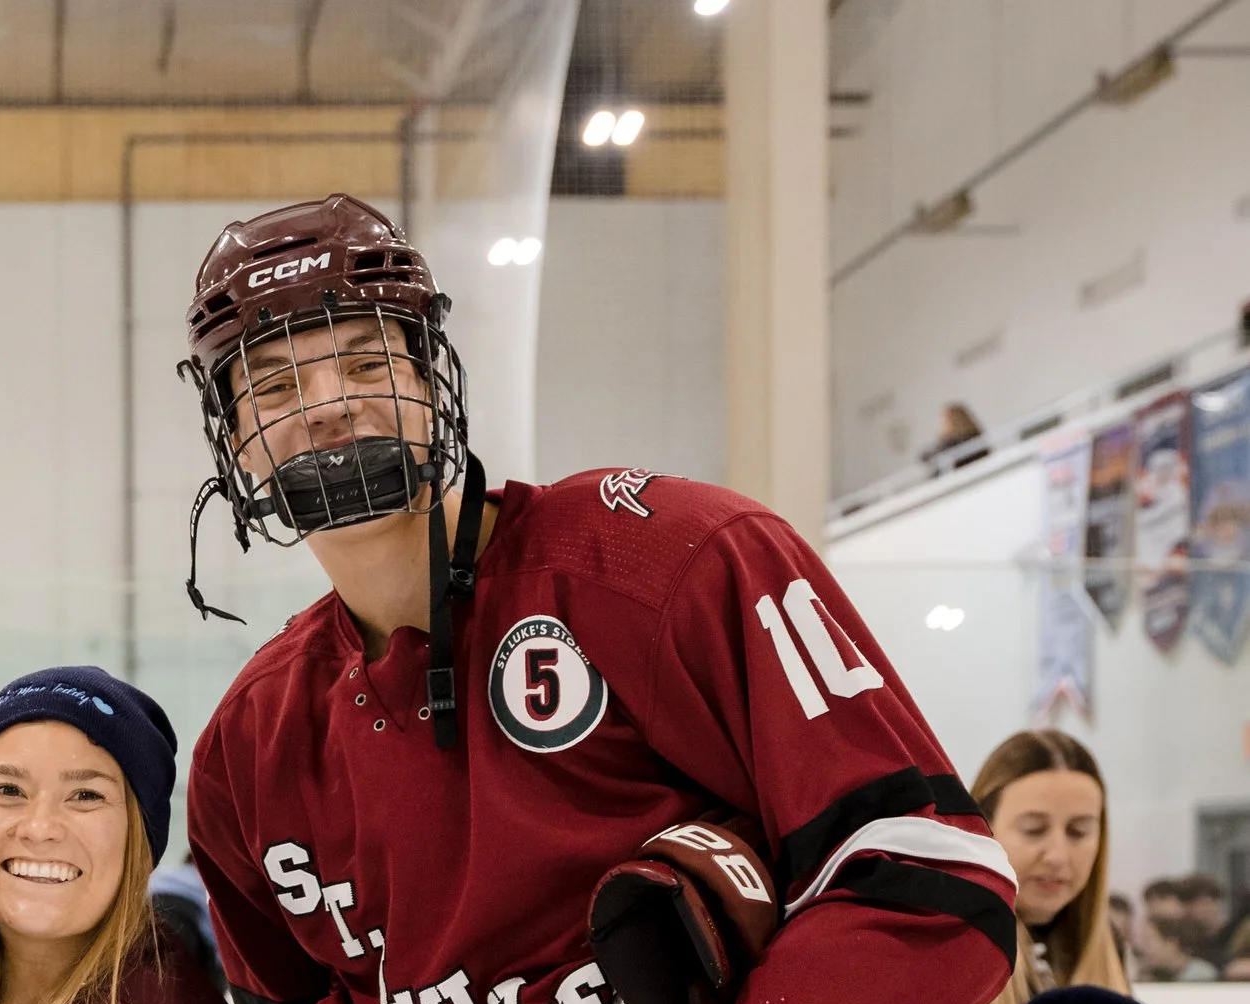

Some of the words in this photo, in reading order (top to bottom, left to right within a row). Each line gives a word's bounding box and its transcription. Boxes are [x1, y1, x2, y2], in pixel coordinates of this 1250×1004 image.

[247, 252, 332, 289] CCM
[497, 650, 510, 669] ST.
[508, 623, 548, 648] LUKE'S
[755, 578, 884, 720] 10
[524, 647, 561, 722] 5
[262, 840, 387, 959] ST.
